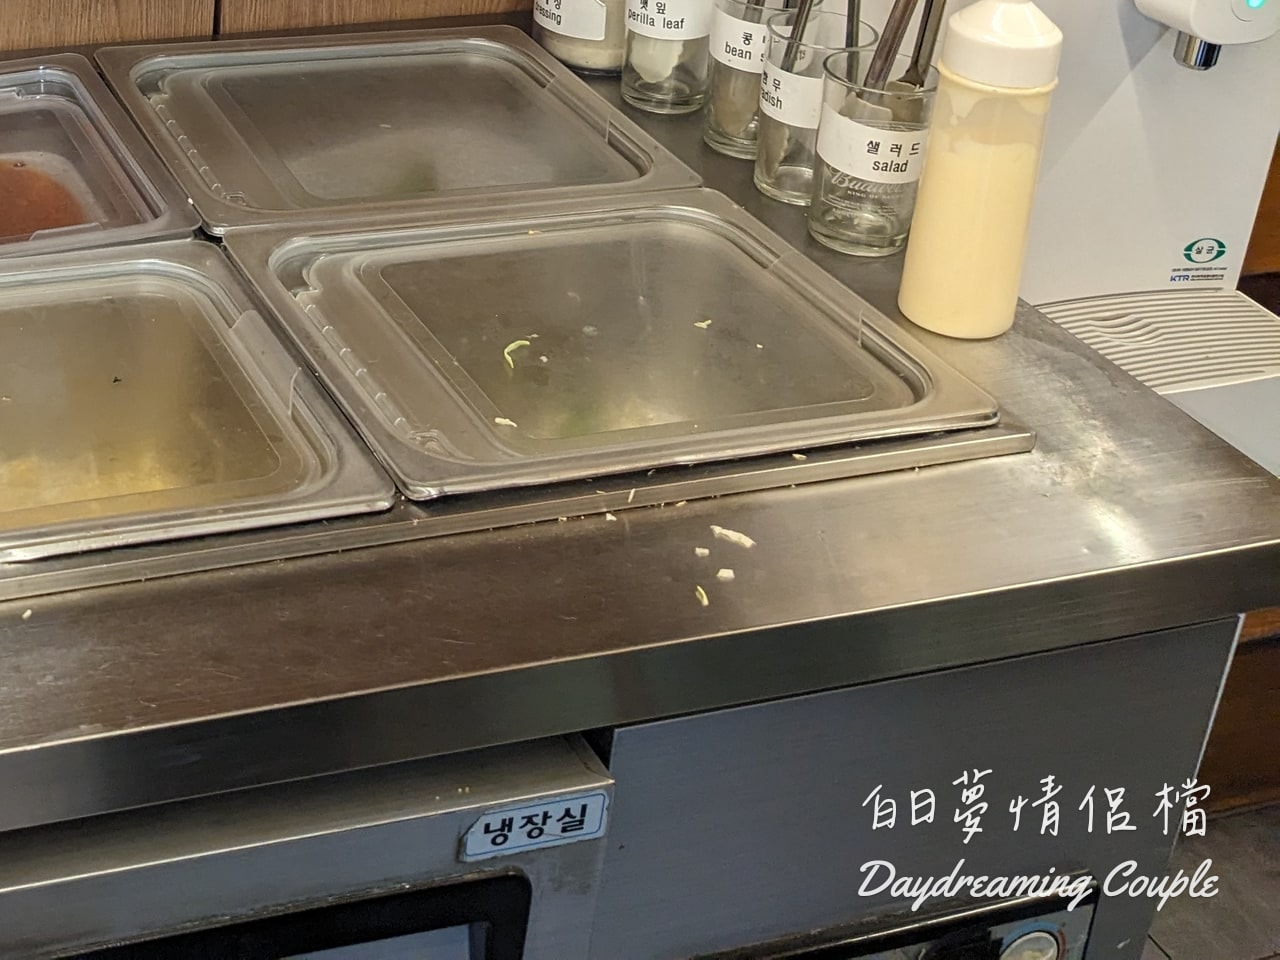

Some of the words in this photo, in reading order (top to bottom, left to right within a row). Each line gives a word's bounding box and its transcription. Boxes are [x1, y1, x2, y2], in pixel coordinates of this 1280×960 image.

[628, 7, 655, 27] perilla
[662, 17, 686, 30] leaf
[724, 41, 752, 61] bean
[866, 139, 921, 158] 샐러드
[872, 159, 910, 173] salad
[1170, 274, 1190, 282] KTR
[483, 803, 588, 847] 냉장실
